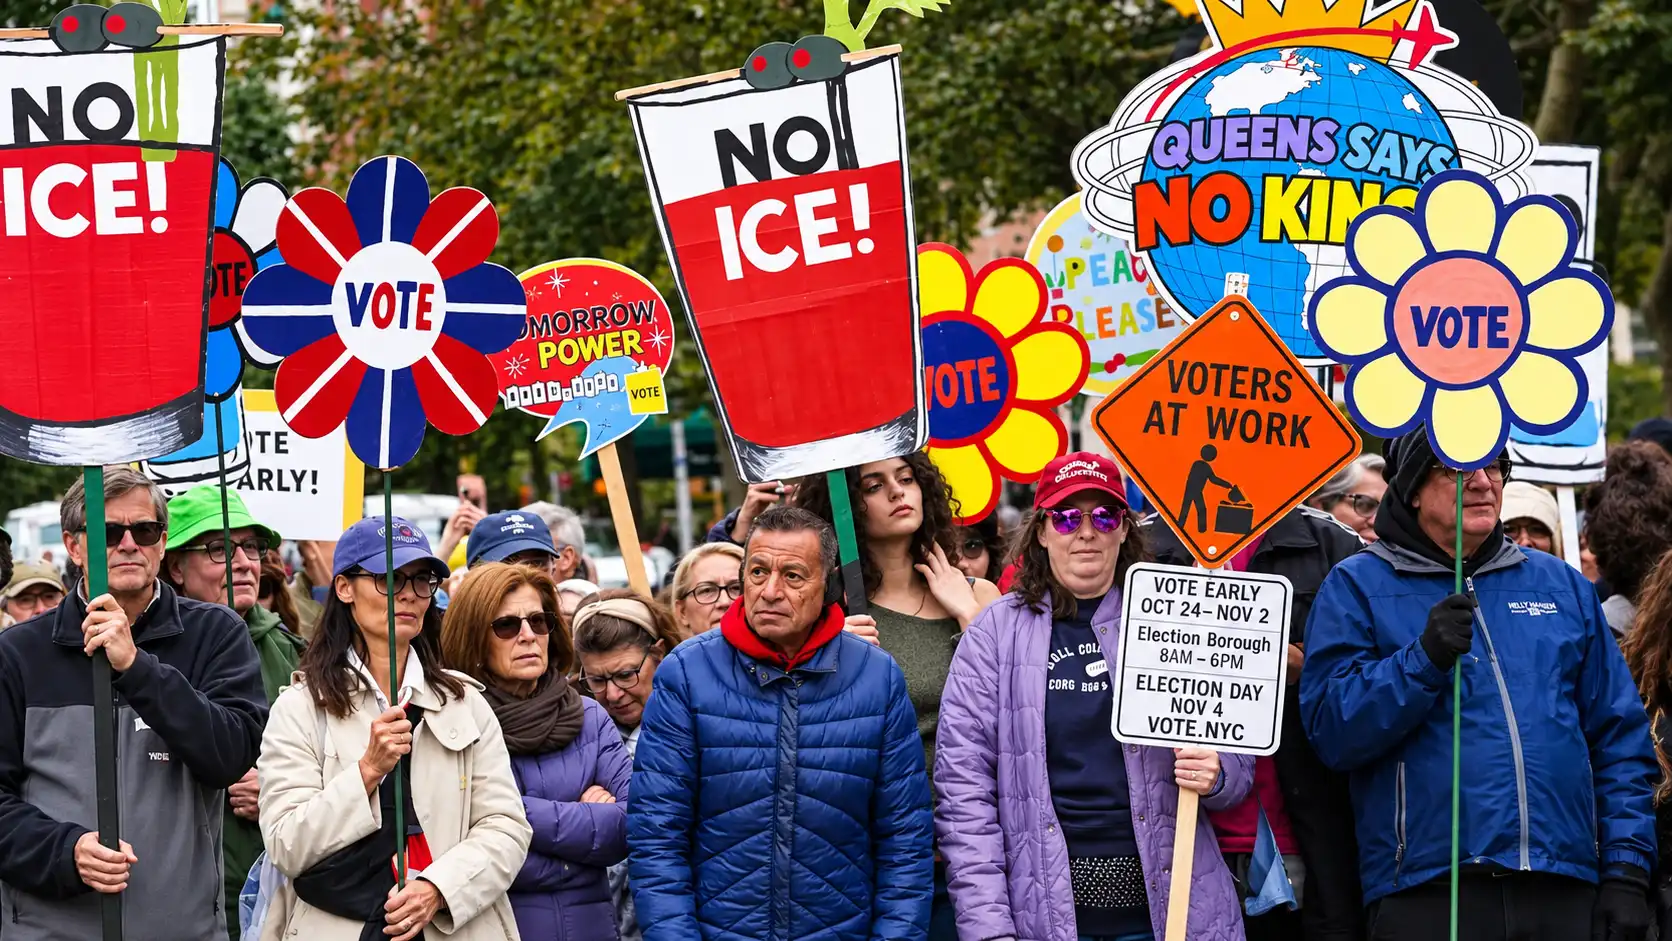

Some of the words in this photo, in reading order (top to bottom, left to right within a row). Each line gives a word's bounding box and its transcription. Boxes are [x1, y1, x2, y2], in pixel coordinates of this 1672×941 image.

[11, 82, 135, 145] NO
[714, 115, 831, 189] NO
[1152, 114, 1342, 171] QUEENS
[1340, 122, 1457, 185] SAYS
[3, 160, 169, 239] ICE!
[1132, 170, 1254, 252] NO
[714, 182, 875, 281] ICE!
[345, 281, 435, 331] VOTE
[1410, 305, 1510, 349] VOTE
[537, 329, 645, 369] POWER
[630, 386, 660, 400] VOTE
[1167, 359, 1294, 403] VOTERS
[249, 430, 289, 454] TE
[1143, 400, 1188, 437] AT
[1206, 405, 1313, 449] WORK
[1154, 576, 1199, 597] VOTE
[1205, 581, 1261, 602] EARLY
[1141, 597, 1175, 615] OCT
[1259, 608, 1270, 624] 2
[1138, 626, 1200, 646] Election
[1207, 632, 1271, 655] Borough
[1160, 648, 1193, 665] 8AM
[1210, 652, 1244, 670] 6PM
[1136, 674, 1223, 698] ELECTION
[1230, 683, 1264, 702] DAY
[1170, 697, 1207, 716] NOV
[1213, 701, 1224, 717] 4
[1148, 716, 1245, 741] VOTE.NYC
